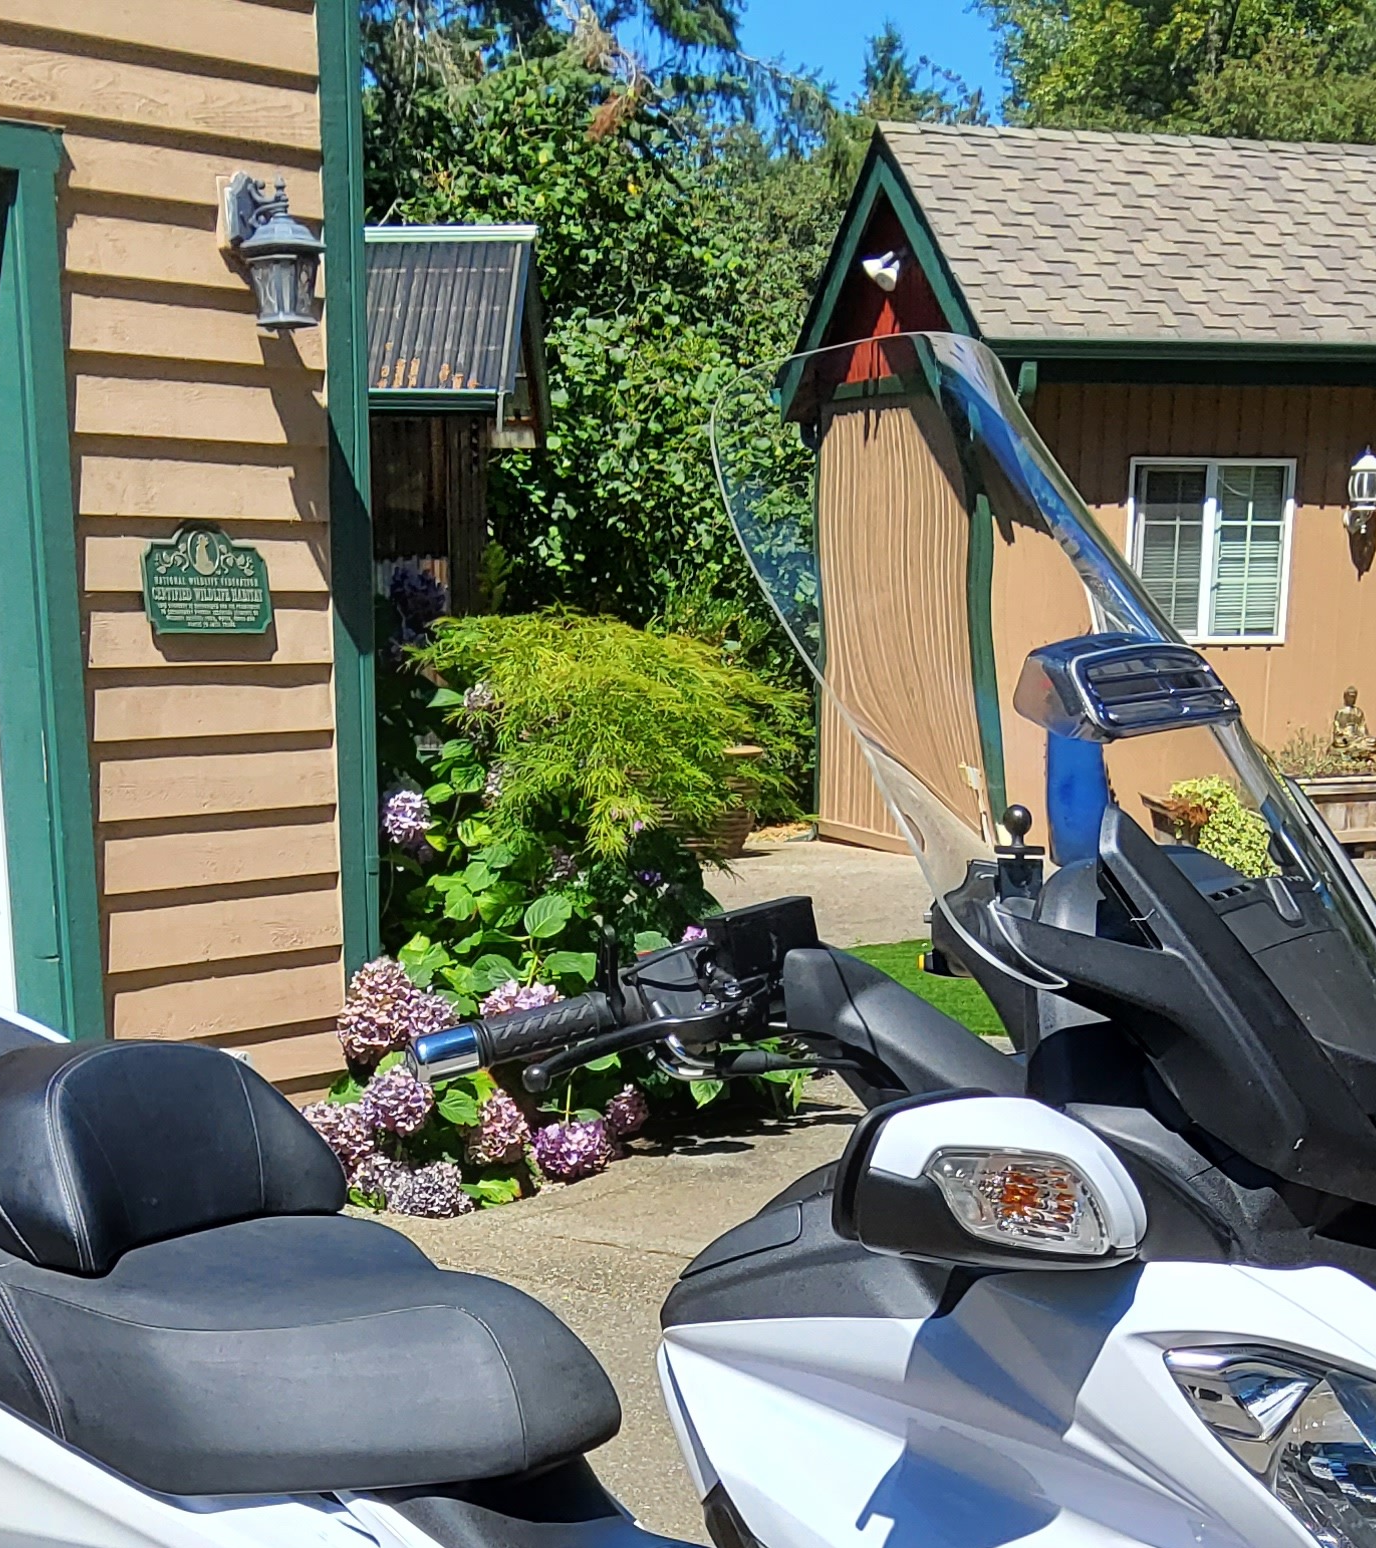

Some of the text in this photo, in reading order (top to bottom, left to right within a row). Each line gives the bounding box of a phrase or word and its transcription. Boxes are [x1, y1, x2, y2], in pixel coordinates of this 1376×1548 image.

[154, 576, 186, 585] NATIONAL
[188, 577, 218, 586] WILDLIFE
[152, 587, 192, 601] CERTIFIED
[193, 588, 231, 602] WILDLIFE
